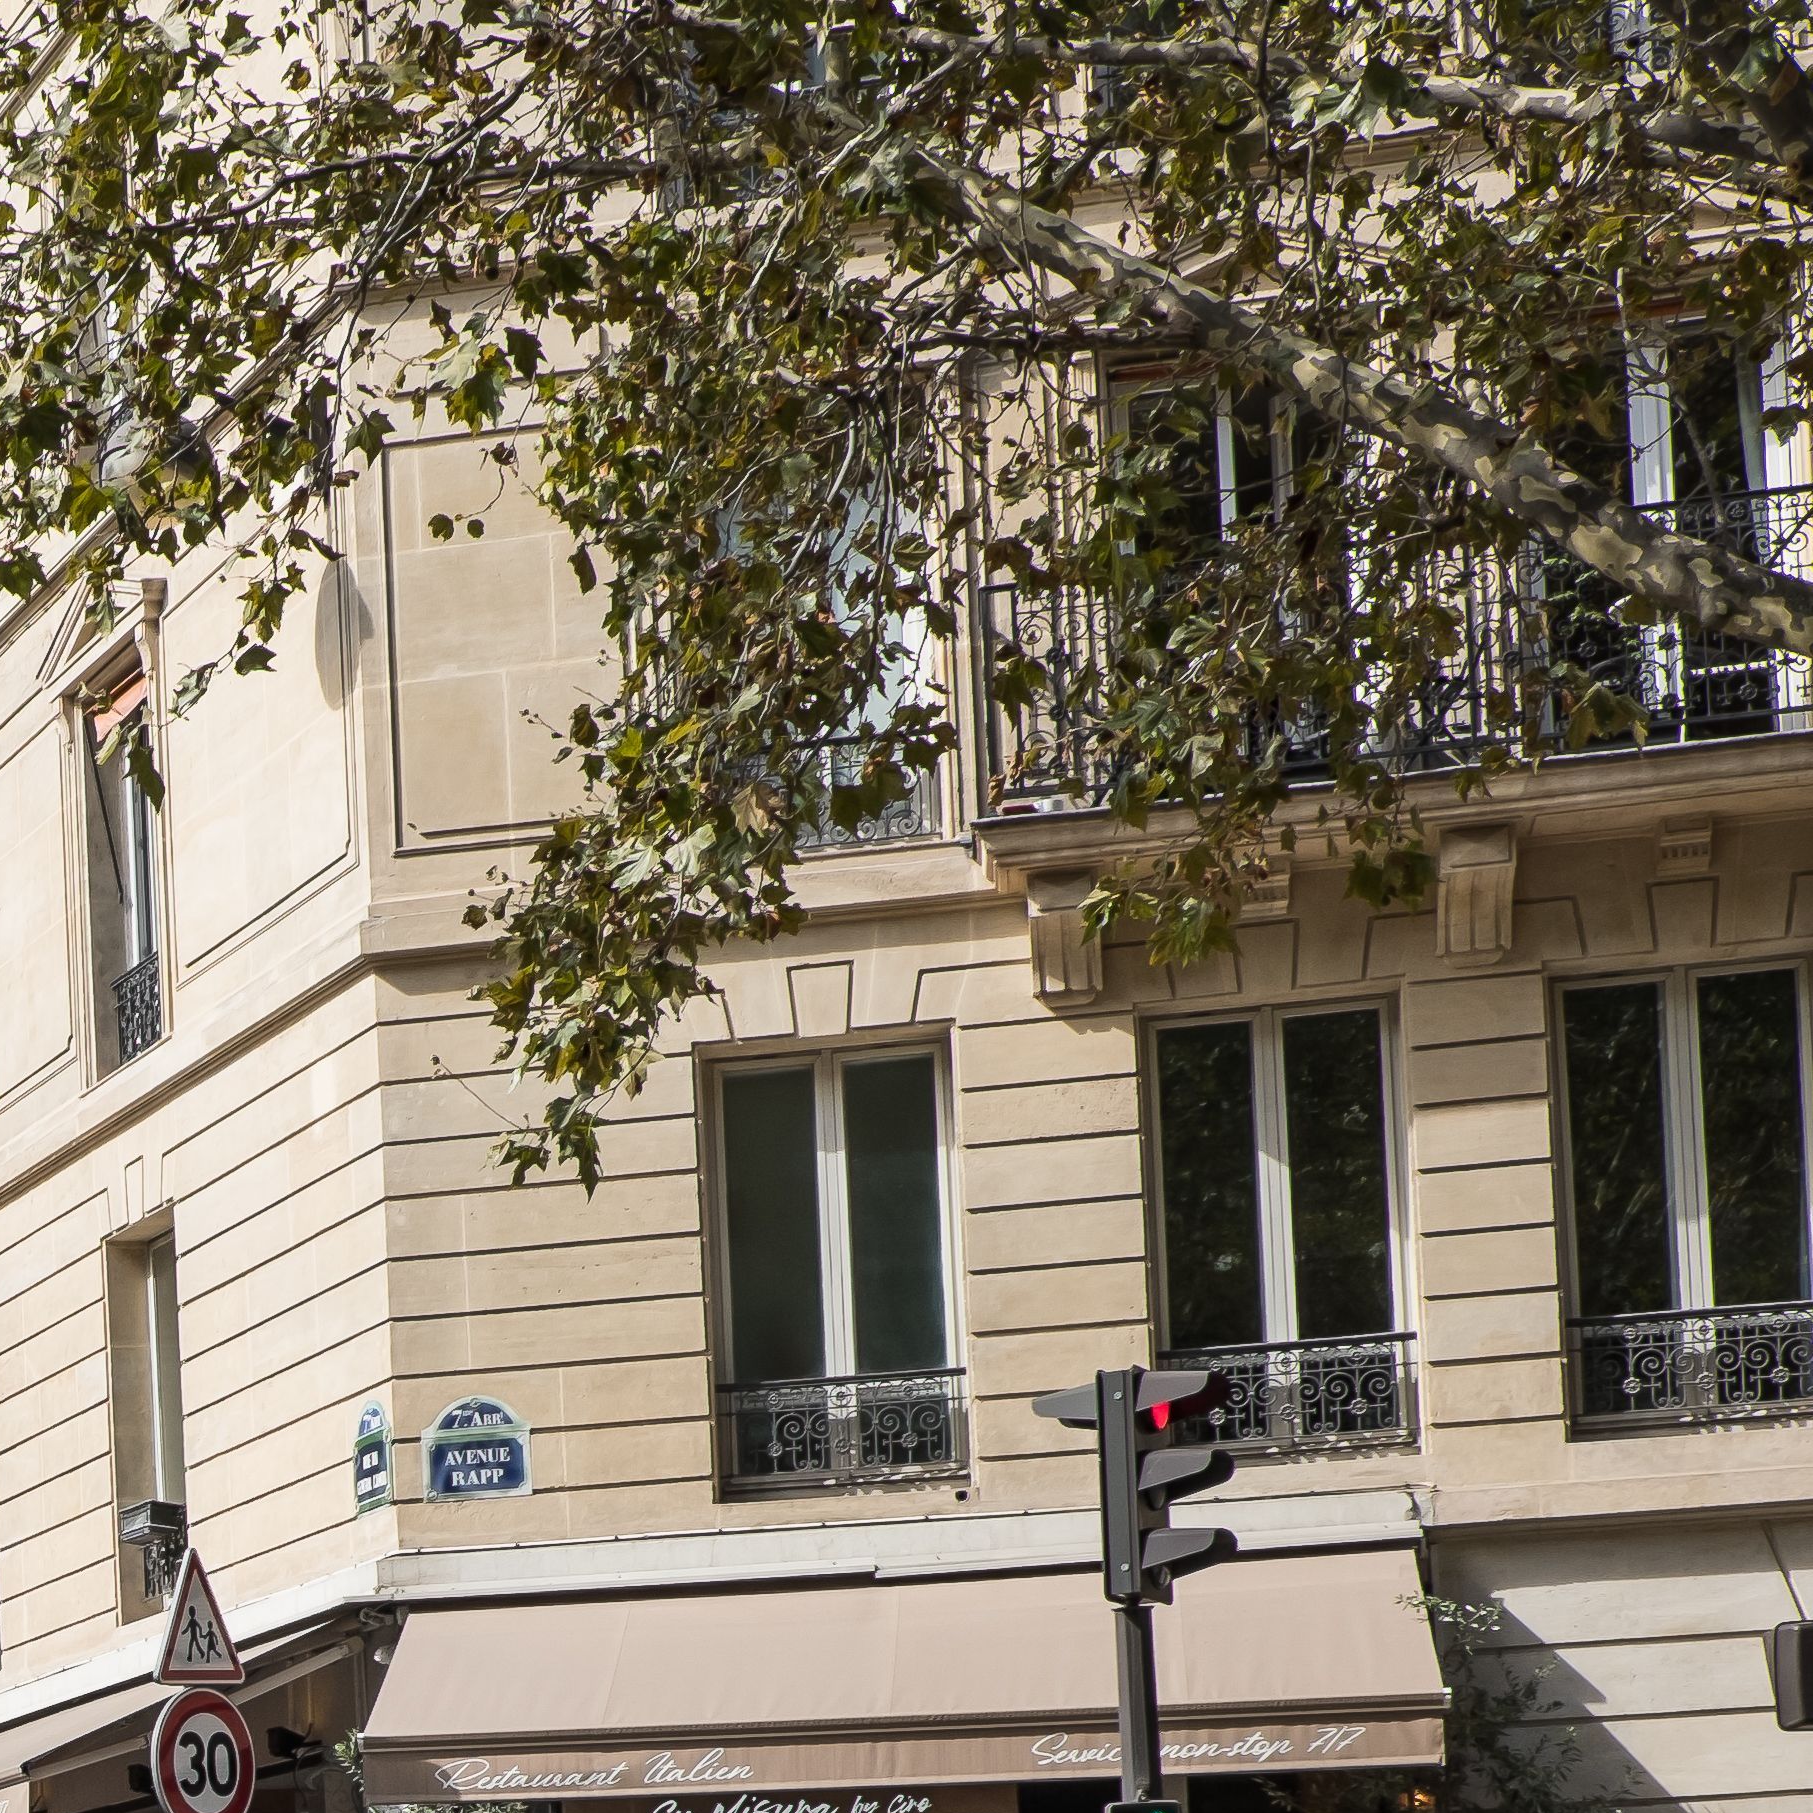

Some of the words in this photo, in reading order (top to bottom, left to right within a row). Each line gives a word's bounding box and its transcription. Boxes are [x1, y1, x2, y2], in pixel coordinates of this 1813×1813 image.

[444, 1447, 511, 1467] AVENUE
[451, 1468, 504, 1487] RAPP
[178, 1731, 238, 1797] 30
[1031, 1731, 1122, 1766] Servic
[1160, 1731, 1296, 1763] non-stop
[1306, 1726, 1367, 1754] 7/7
[434, 1757, 630, 1791] Restaurant
[642, 1747, 756, 1786] Italien
